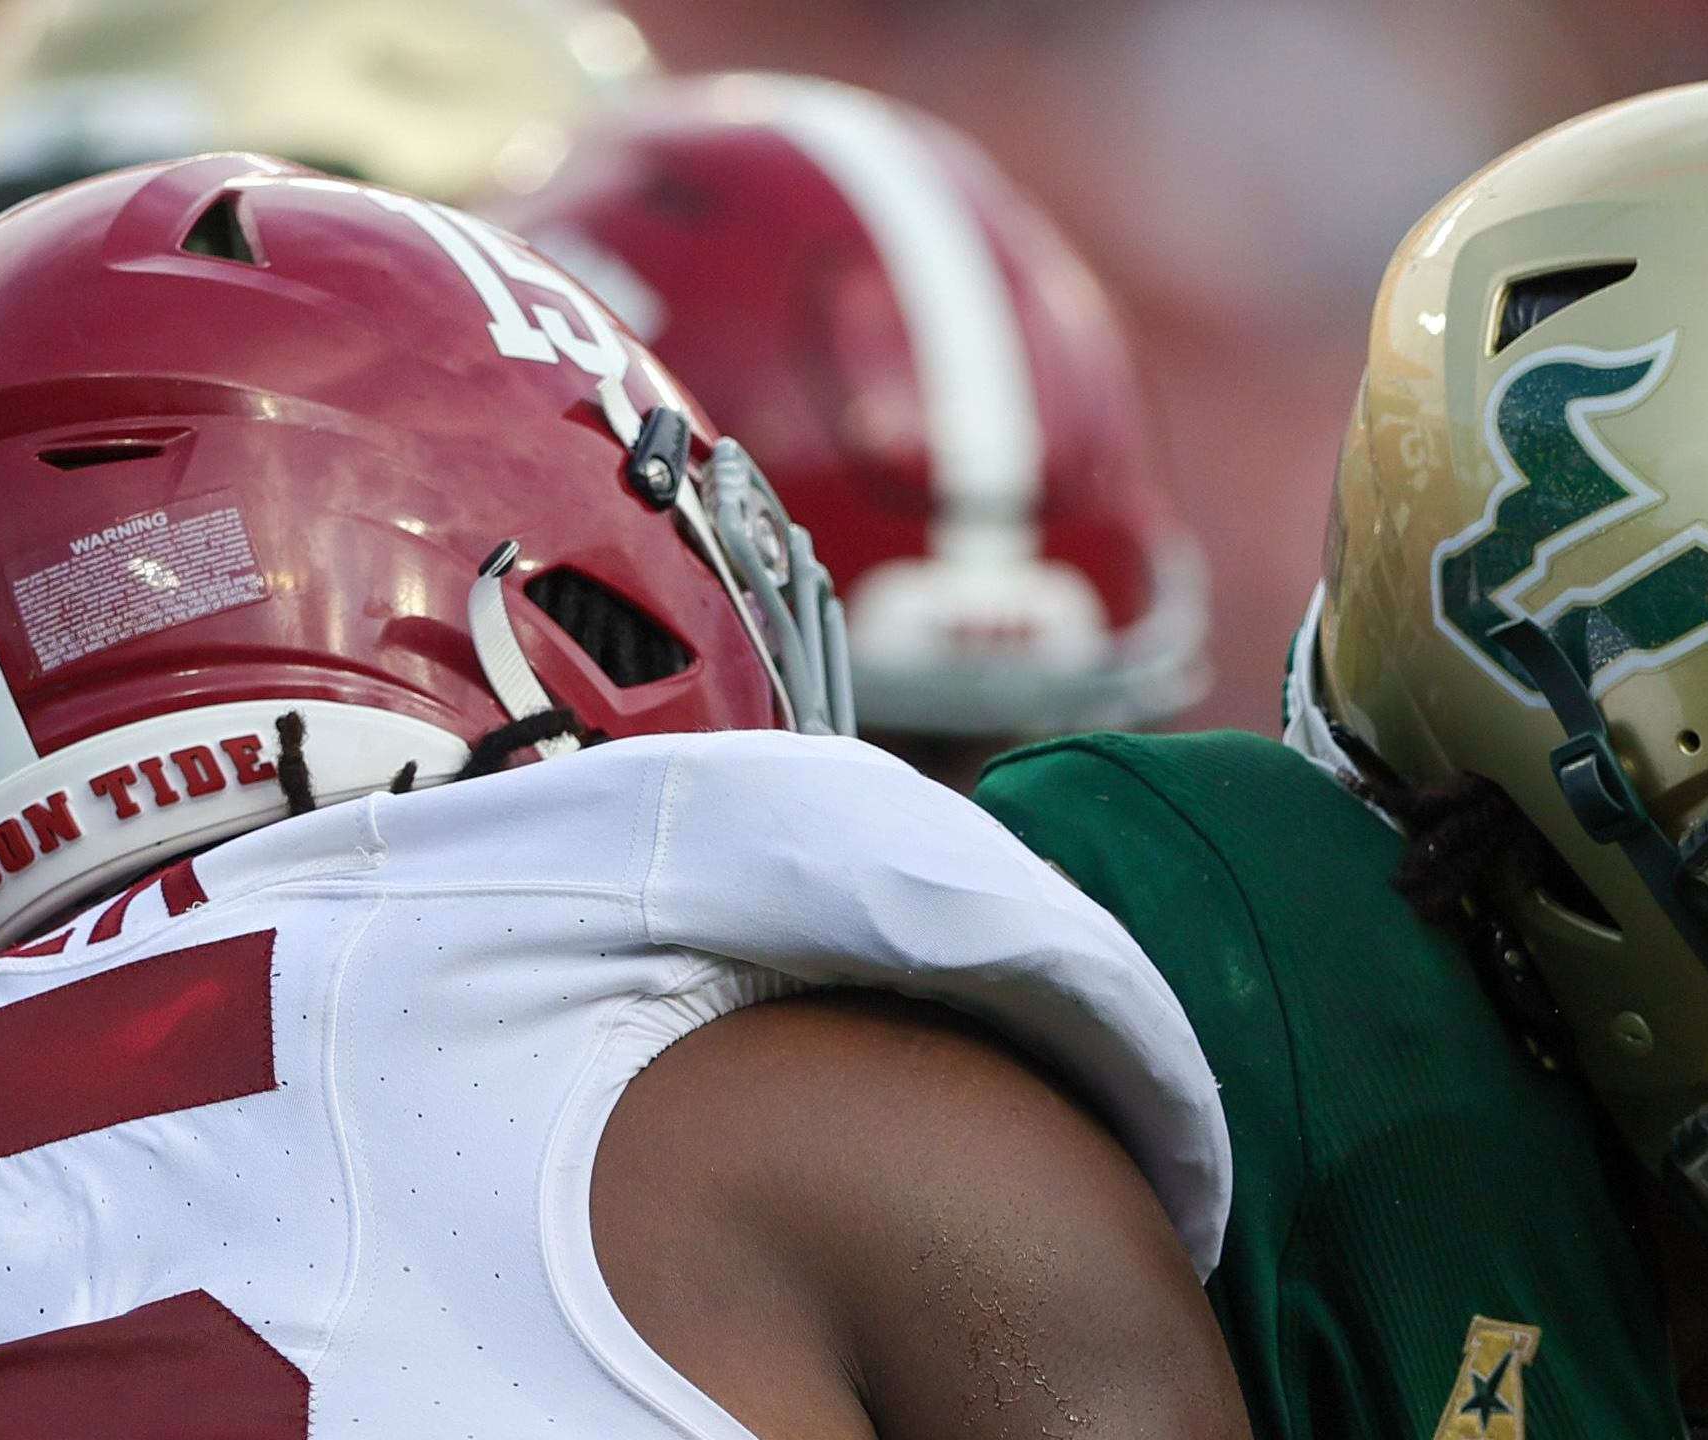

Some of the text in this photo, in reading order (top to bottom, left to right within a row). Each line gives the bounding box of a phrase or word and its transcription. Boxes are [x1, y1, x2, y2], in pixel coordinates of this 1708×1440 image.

[365, 188, 629, 378] 15
[69, 511, 168, 555] WARNING
[89, 734, 277, 820] TIDE
